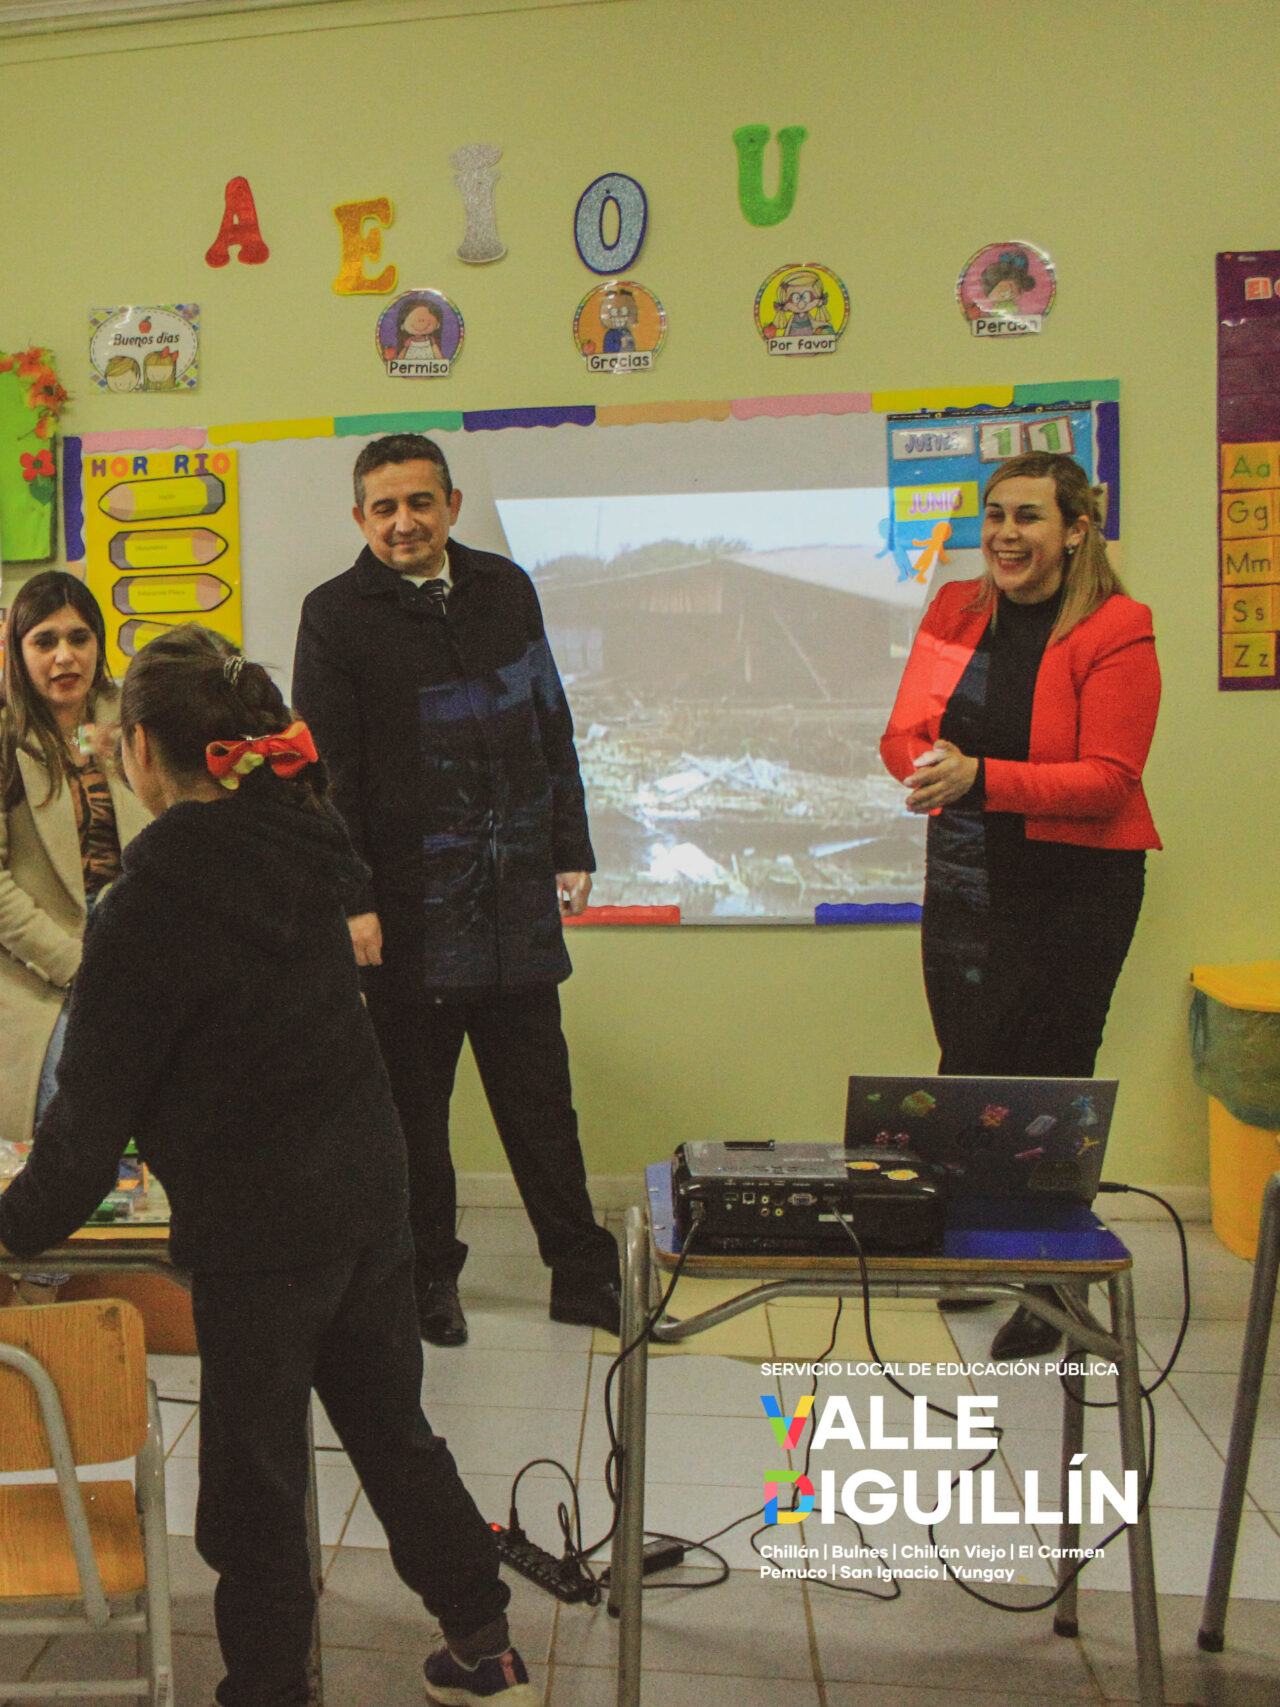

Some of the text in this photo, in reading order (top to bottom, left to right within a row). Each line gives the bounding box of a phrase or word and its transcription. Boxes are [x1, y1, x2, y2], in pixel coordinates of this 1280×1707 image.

[205, 176, 270, 268] A
[333, 196, 398, 295] E
[574, 172, 648, 275] O
[733, 124, 808, 228] U
[113, 333, 153, 347] Buenos
[769, 337, 836, 352] Por favor
[389, 361, 449, 375] Permiso
[590, 354, 650, 369] Gracias
[908, 489, 963, 515] JUNIO
